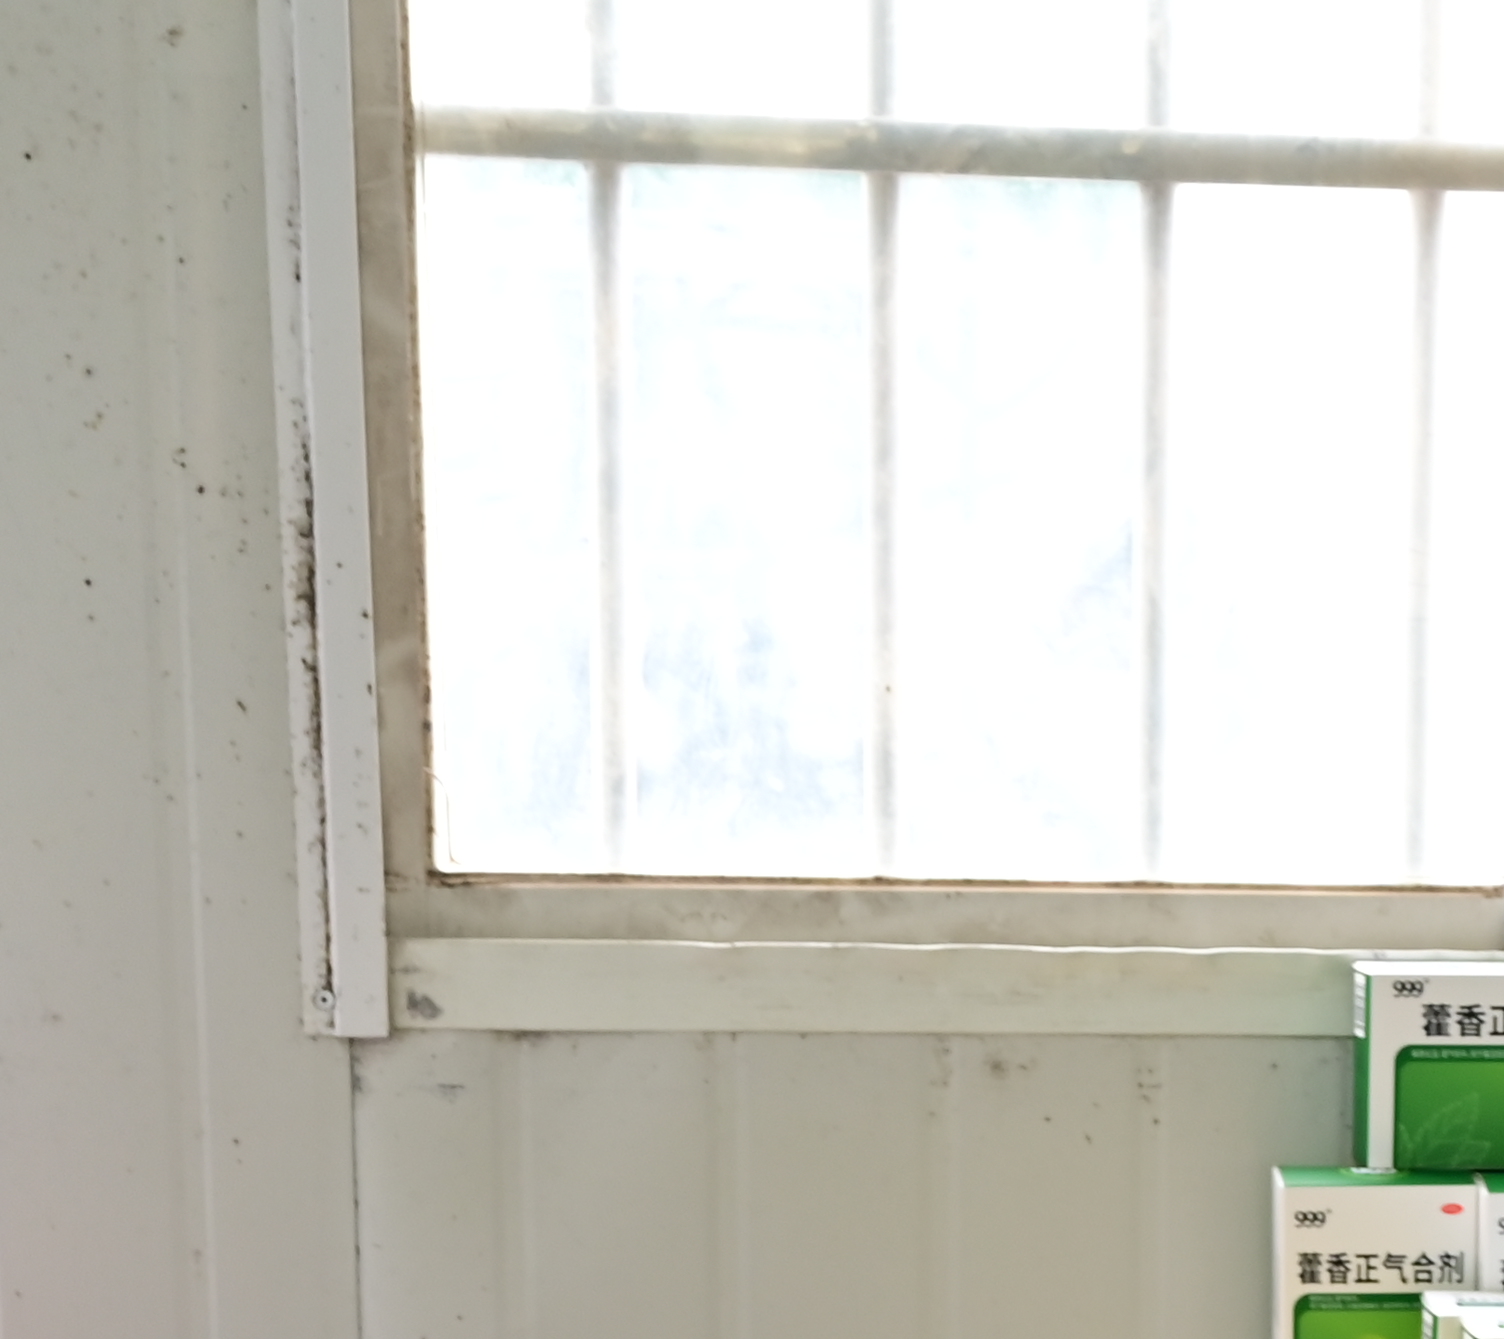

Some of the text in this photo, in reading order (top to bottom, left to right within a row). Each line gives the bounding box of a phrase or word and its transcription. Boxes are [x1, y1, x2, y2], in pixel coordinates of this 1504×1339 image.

[1393, 980, 1427, 998] 999
[1294, 1210, 1326, 1228] 999
[1297, 1252, 1465, 1286] 藿香正气合剂
